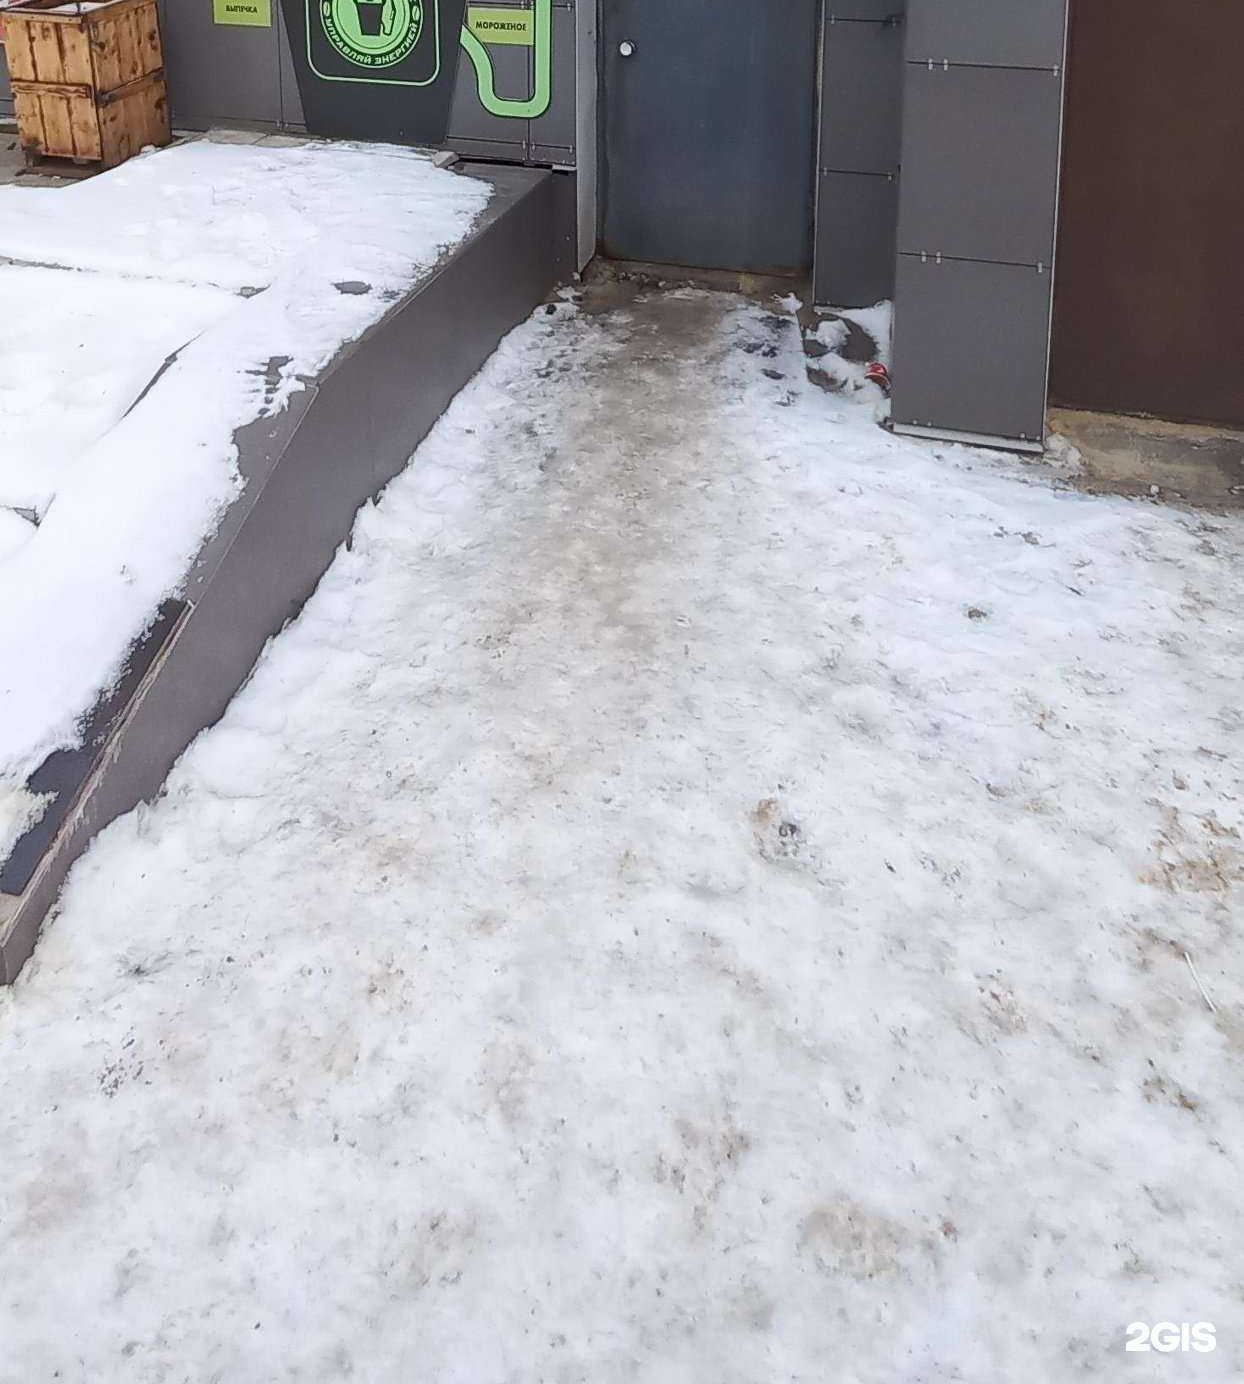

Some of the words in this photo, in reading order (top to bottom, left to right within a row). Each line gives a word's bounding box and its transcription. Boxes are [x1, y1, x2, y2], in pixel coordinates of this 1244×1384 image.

[475, 20, 527, 32] МОРОЖЕНОЕ
[325, 18, 372, 65] УПРАВЛЯЙ
[374, 22, 418, 65] ЭНЕРГИЕЙ
